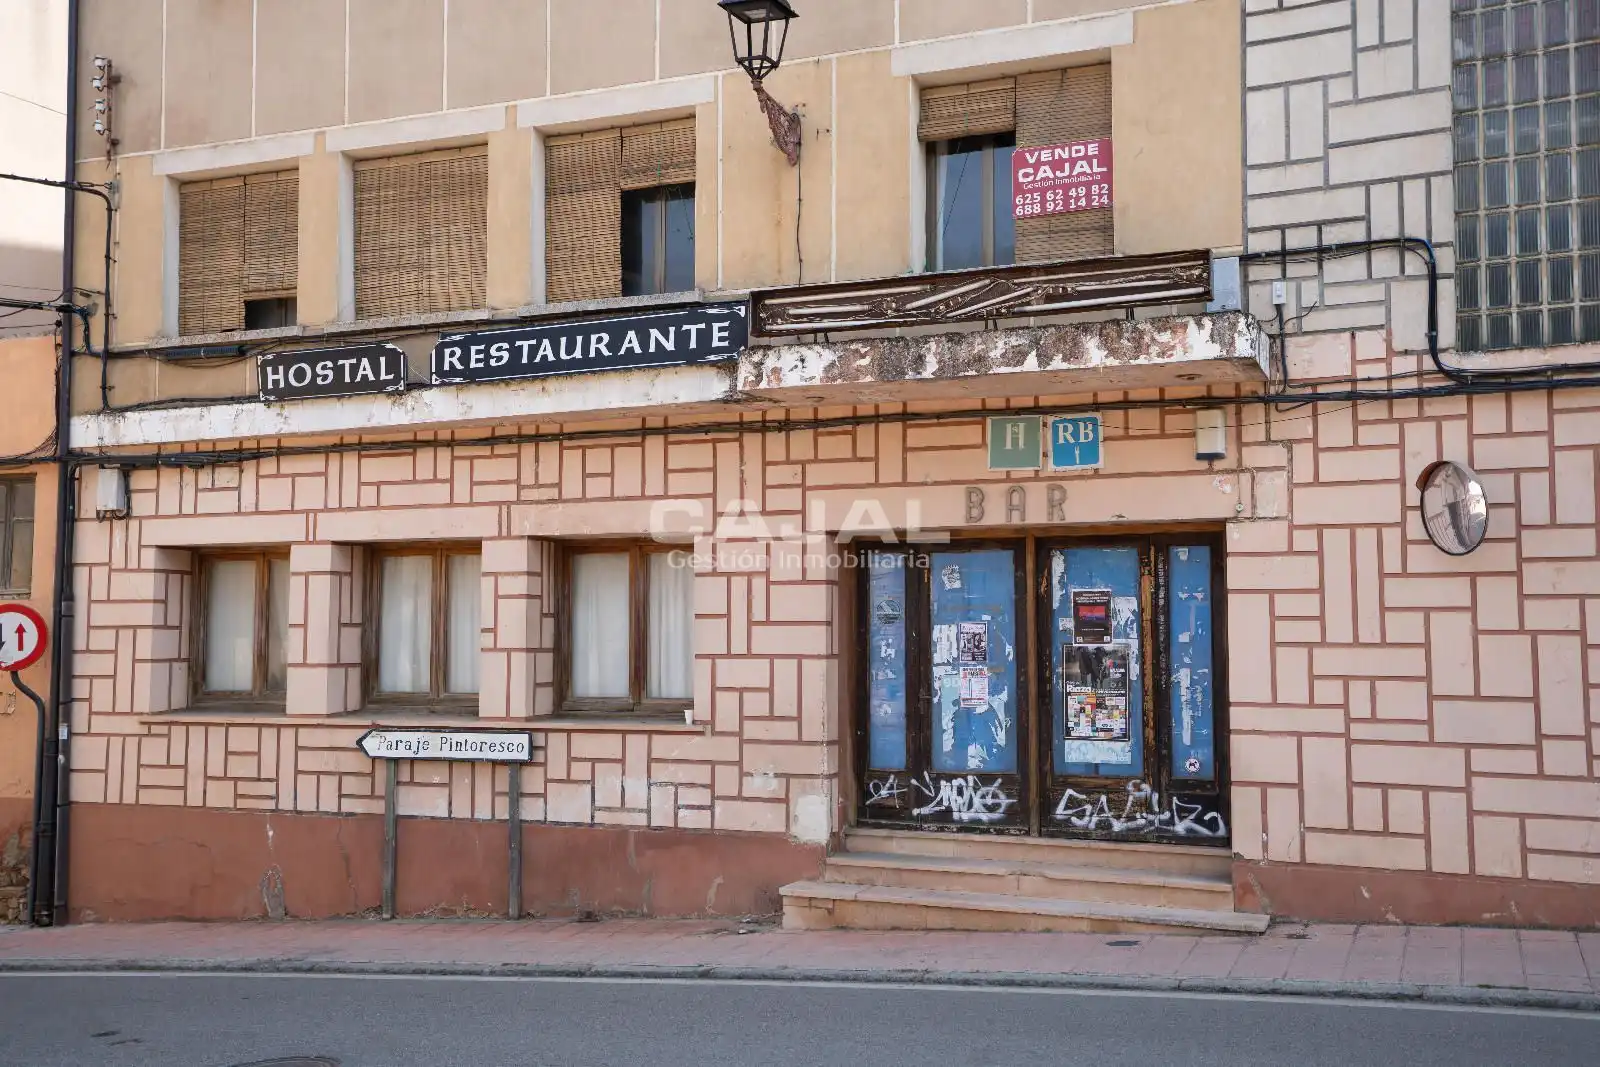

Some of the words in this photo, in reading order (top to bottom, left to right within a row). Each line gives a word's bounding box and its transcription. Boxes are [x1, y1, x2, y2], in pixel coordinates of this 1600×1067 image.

[1025, 143, 1099, 164] VENDE
[1018, 159, 1108, 183] CAJAL
[1016, 192, 1041, 205] 625
[1046, 189, 1064, 201] 62
[1069, 186, 1086, 198] 49
[1091, 183, 1109, 195] 82
[1016, 203, 1041, 216] 688
[1046, 200, 1064, 212] 92
[1069, 197, 1087, 209] 14
[1091, 194, 1109, 206] 24
[443, 320, 732, 372] RESTAURANTE
[266, 356, 394, 390] HOSTAL
[1056, 421, 1094, 445] RB
[965, 483, 1068, 524] BAR
[377, 735, 430, 755] Paraje
[440, 737, 525, 753] Pintoresco
